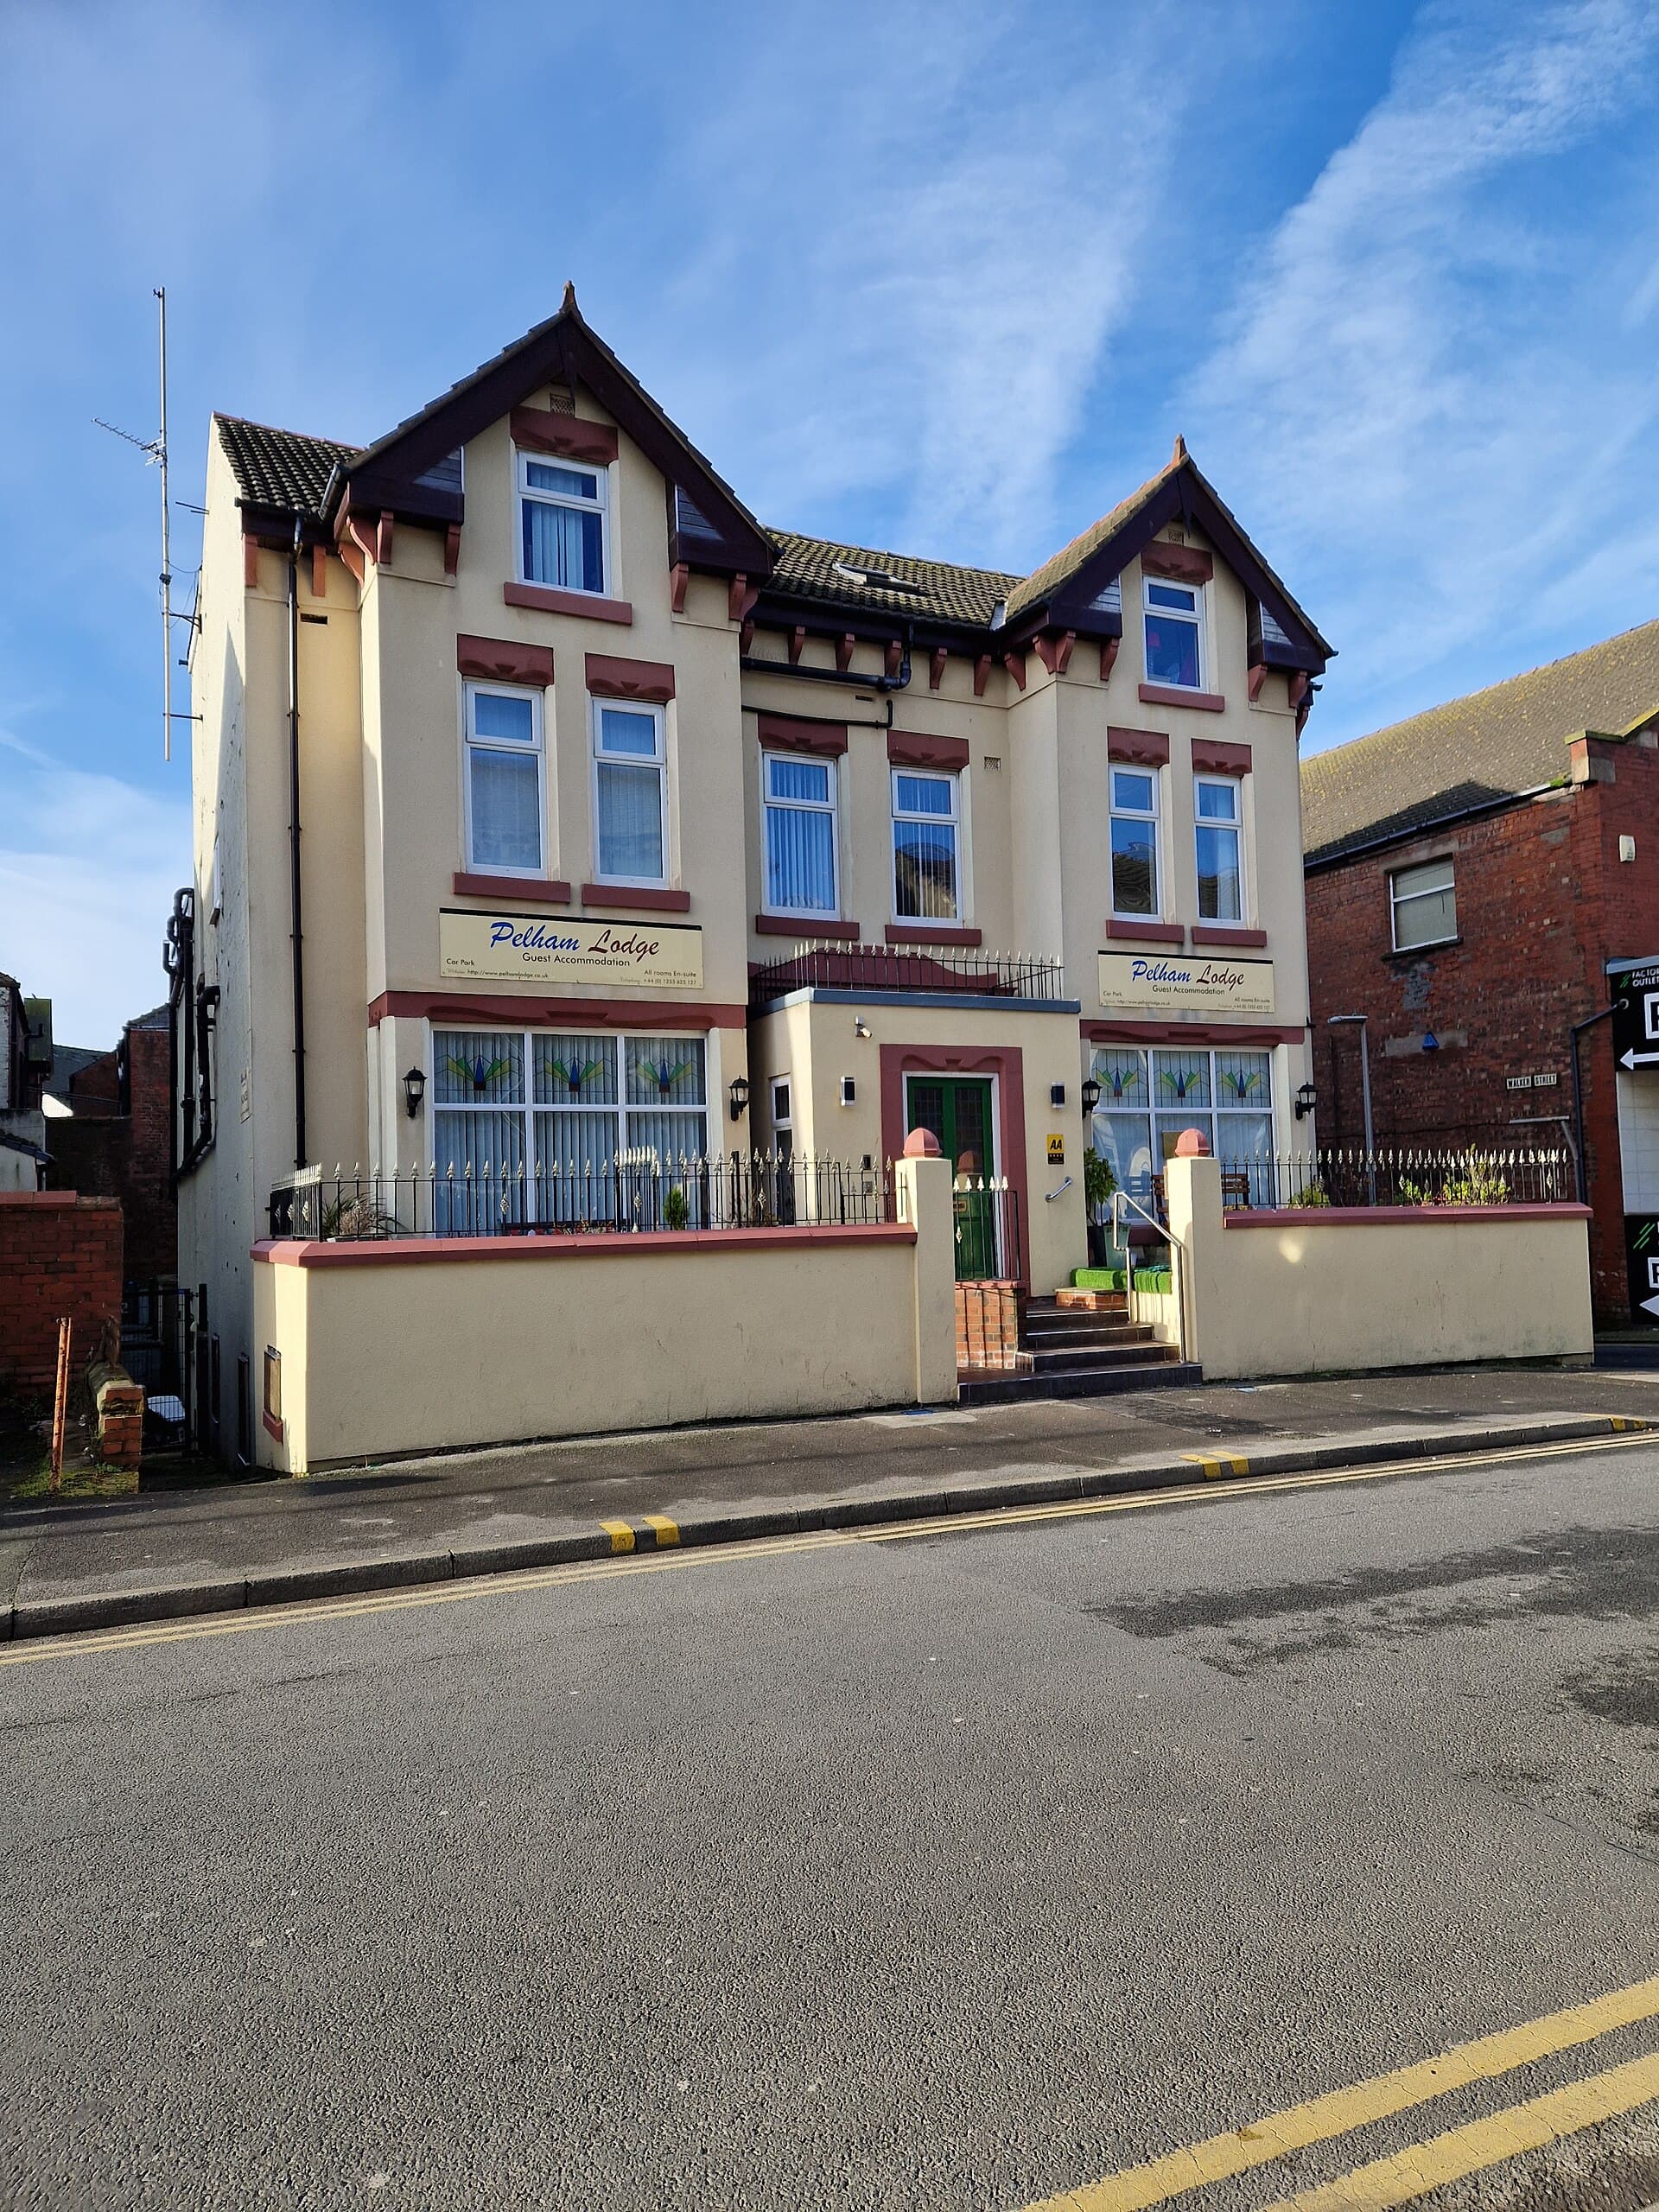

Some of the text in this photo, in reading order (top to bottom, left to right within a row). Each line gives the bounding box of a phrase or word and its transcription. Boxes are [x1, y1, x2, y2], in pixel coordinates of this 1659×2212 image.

[490, 921, 659, 963] Pelham Lodge
[522, 952, 630, 967] Guest Accommodation
[1131, 960, 1245, 991] Pelham Lodge
[1152, 984, 1225, 995] Guest Accommodation
[1508, 1074, 1555, 1087] WALKER STREET
[1050, 1139, 1063, 1150] AA
